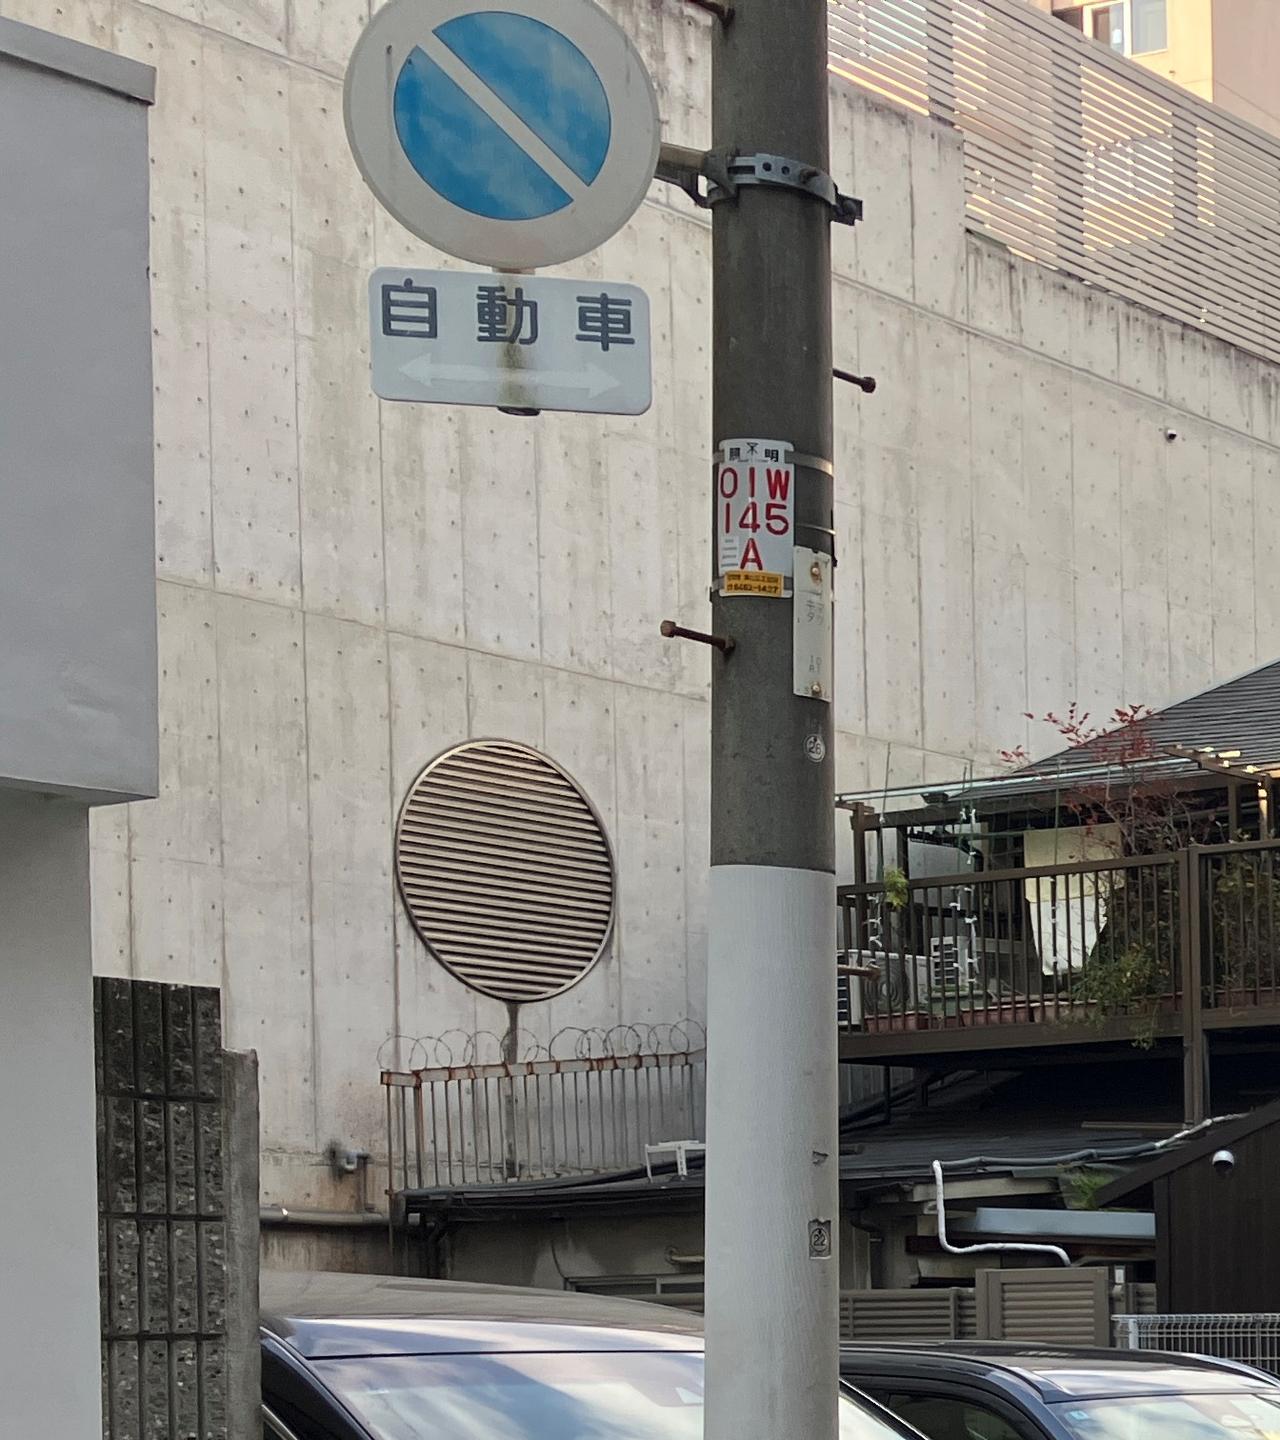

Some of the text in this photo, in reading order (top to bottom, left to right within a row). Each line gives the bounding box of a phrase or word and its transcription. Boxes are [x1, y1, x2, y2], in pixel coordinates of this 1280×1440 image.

[381, 279, 635, 351] 自動車
[725, 502, 789, 535] 145
[740, 538, 762, 570] A
